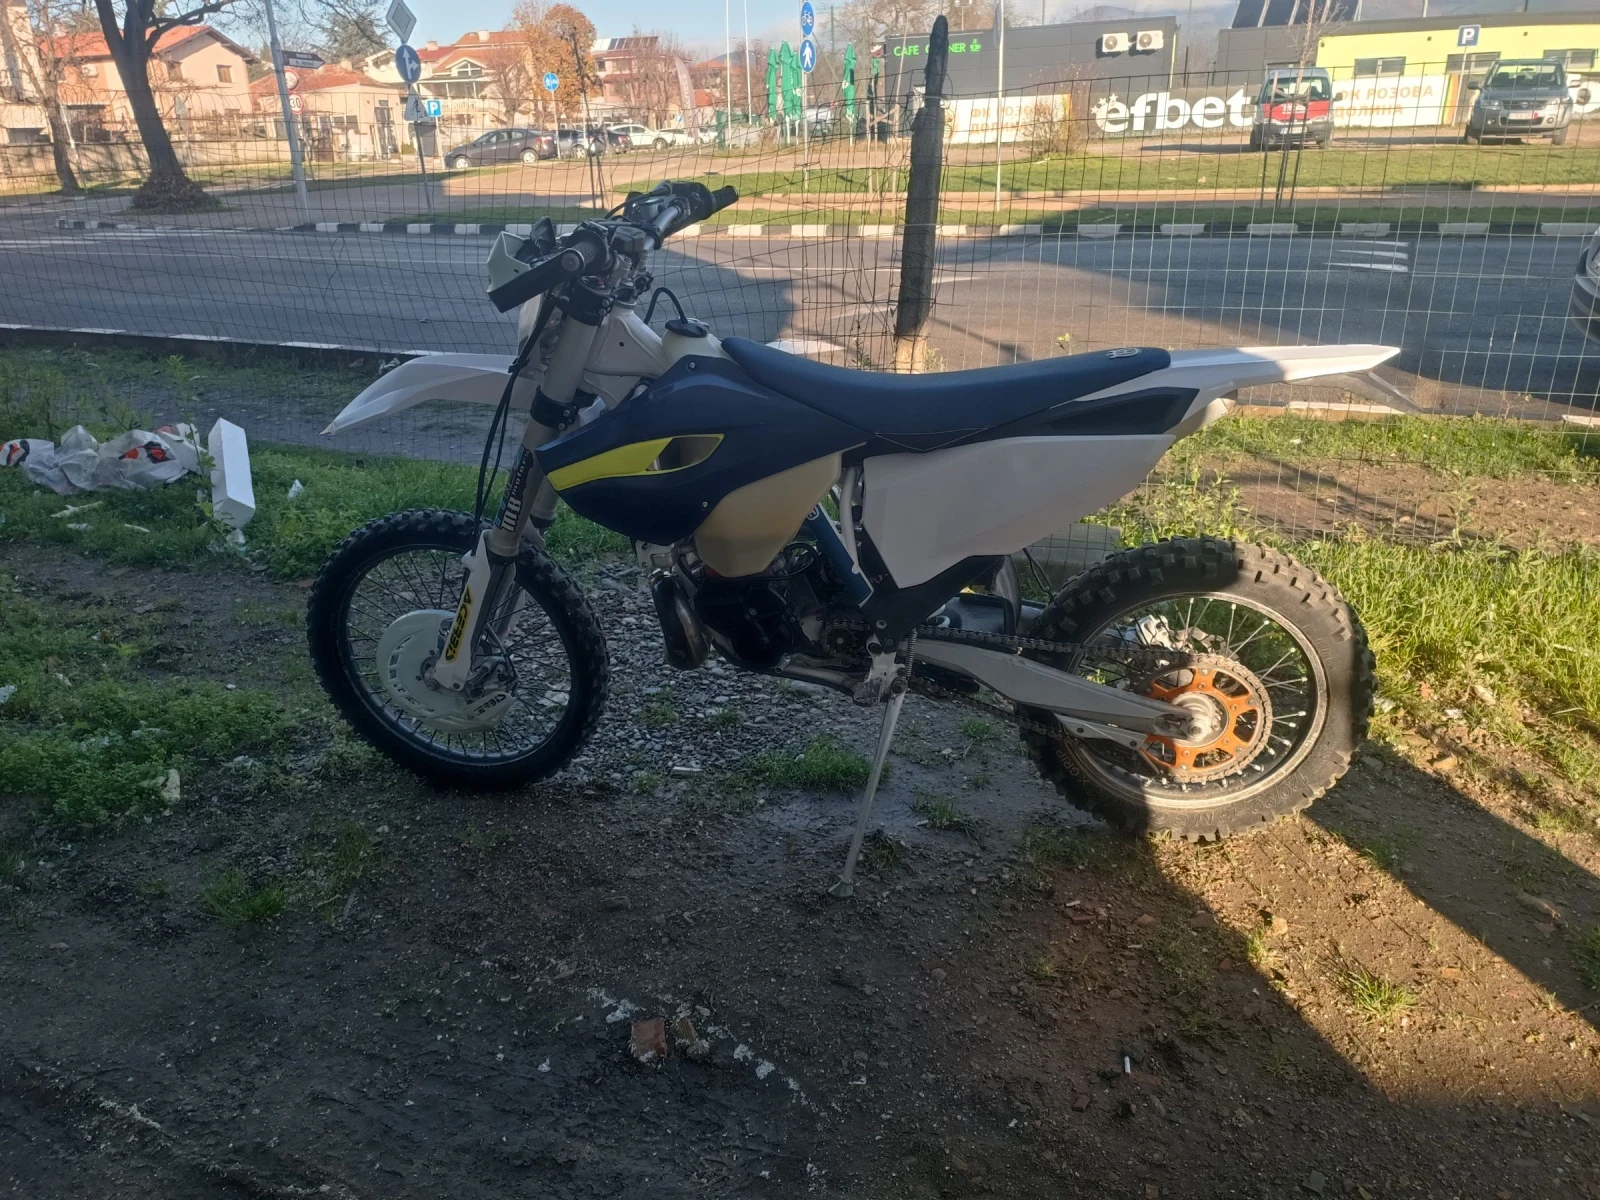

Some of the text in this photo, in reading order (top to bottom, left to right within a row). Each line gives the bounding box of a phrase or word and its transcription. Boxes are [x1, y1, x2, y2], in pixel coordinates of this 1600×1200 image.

[1461, 28, 1475, 45] P
[893, 42, 966, 57] CAFE CNER
[1366, 85, 1433, 99] РОЗОВА
[289, 97, 301, 109] 30
[429, 101, 439, 115] P
[1095, 88, 1253, 133] efbet
[1335, 104, 1404, 119] ДОЛИНА
